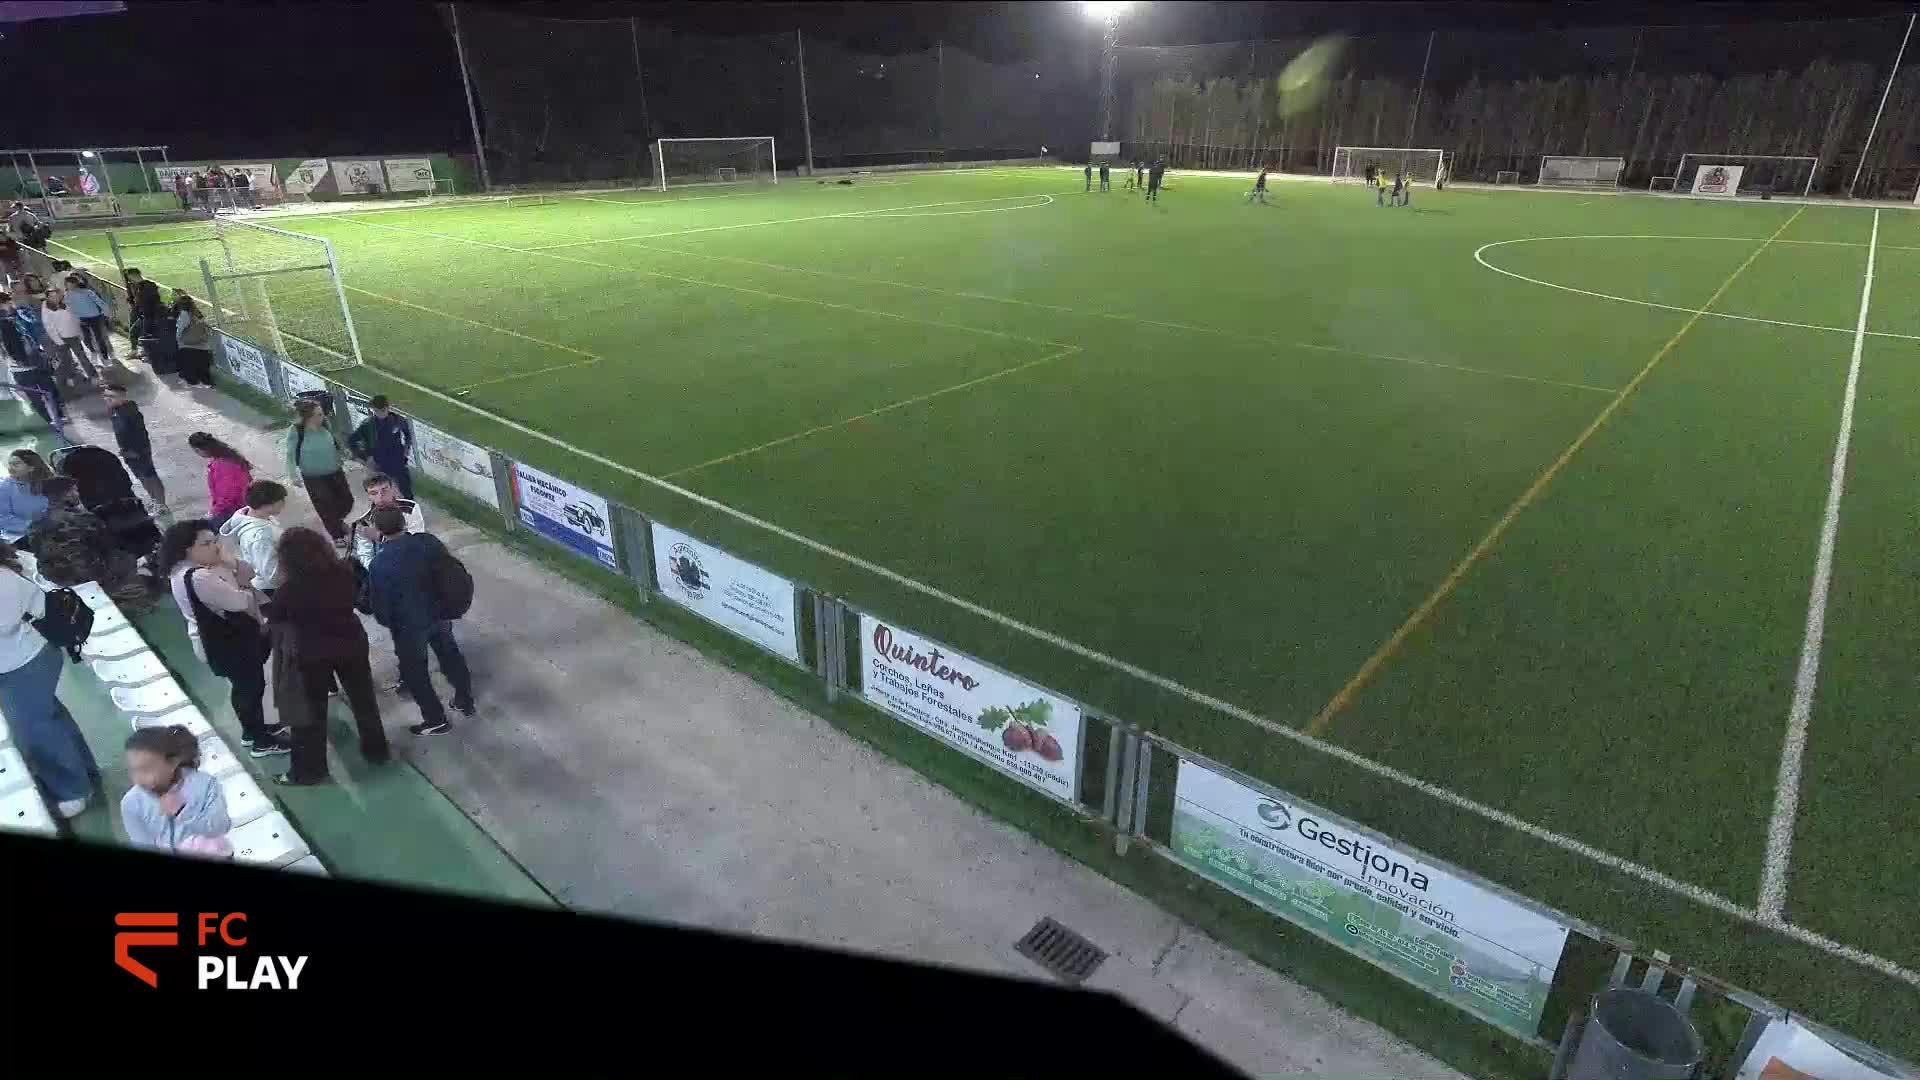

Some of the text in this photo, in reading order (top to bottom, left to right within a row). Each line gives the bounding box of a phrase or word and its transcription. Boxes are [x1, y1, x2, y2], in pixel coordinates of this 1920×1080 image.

[515, 470, 537, 484] TALLER
[872, 658, 945, 699] Corchos, Leñas
[873, 623, 980, 691] Quintero
[880, 672, 919, 697] Trabajos
[921, 692, 973, 724] Forestales
[1239, 828, 1249, 838] Tu
[1250, 834, 1304, 864] constructora
[1327, 870, 1344, 881] por
[1376, 892, 1409, 913] calidad
[1418, 912, 1460, 938] servicio.
[1297, 817, 1429, 892] Gestiona
